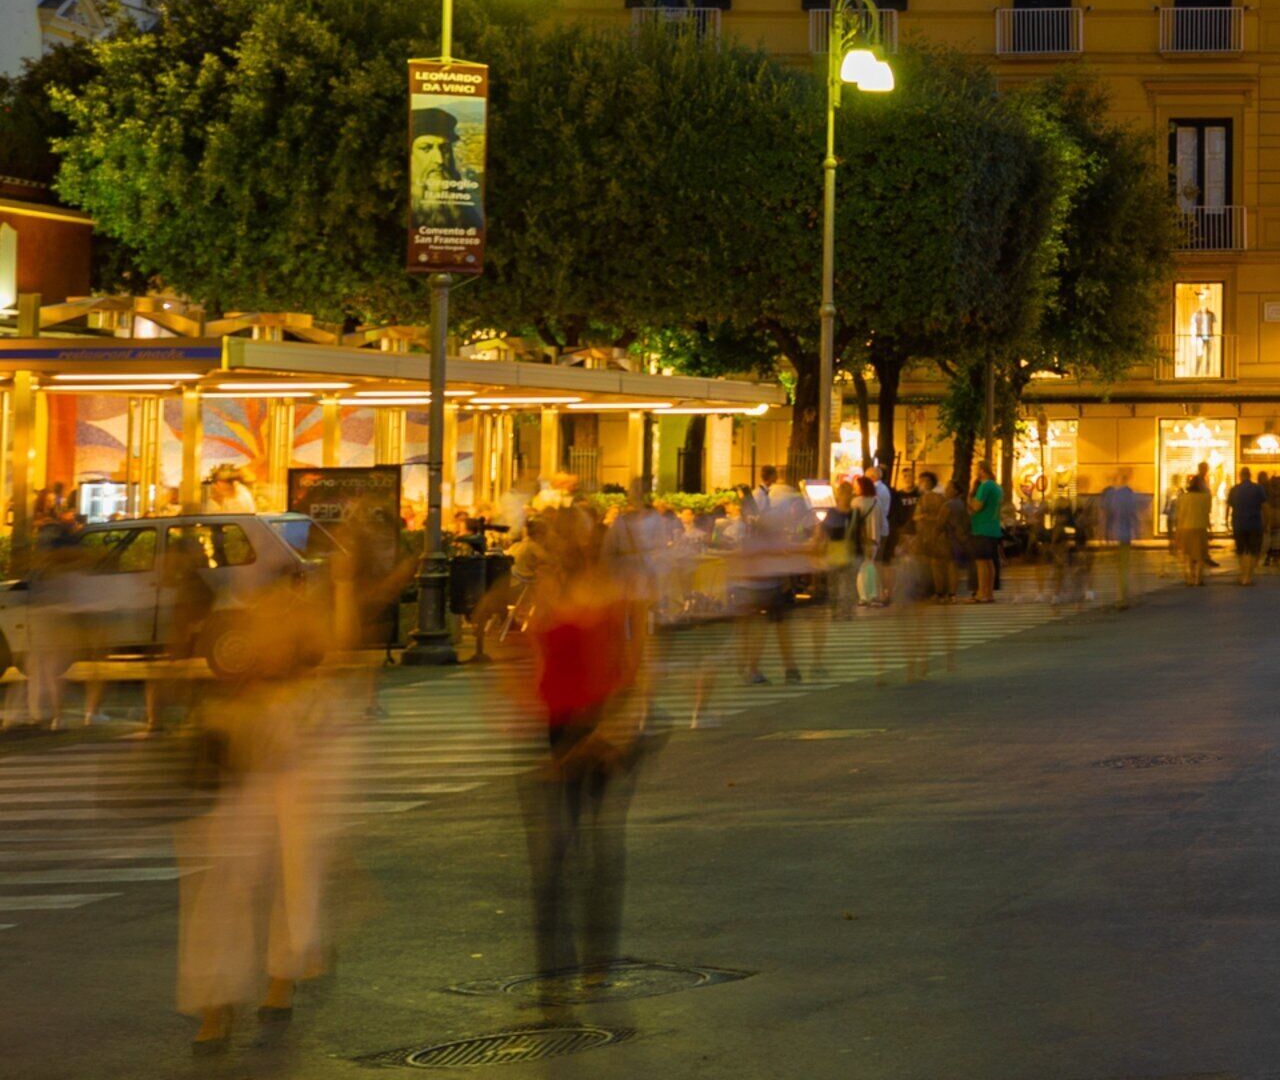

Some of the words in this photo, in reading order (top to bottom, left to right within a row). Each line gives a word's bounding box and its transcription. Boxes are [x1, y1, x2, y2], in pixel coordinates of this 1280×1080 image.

[415, 71, 483, 84] LEONARDO
[422, 83, 441, 92] DA
[442, 84, 476, 94] VINCI
[418, 225, 466, 237] Convento
[466, 227, 477, 236] di
[414, 234, 432, 244] San
[433, 235, 481, 246] Francesco
